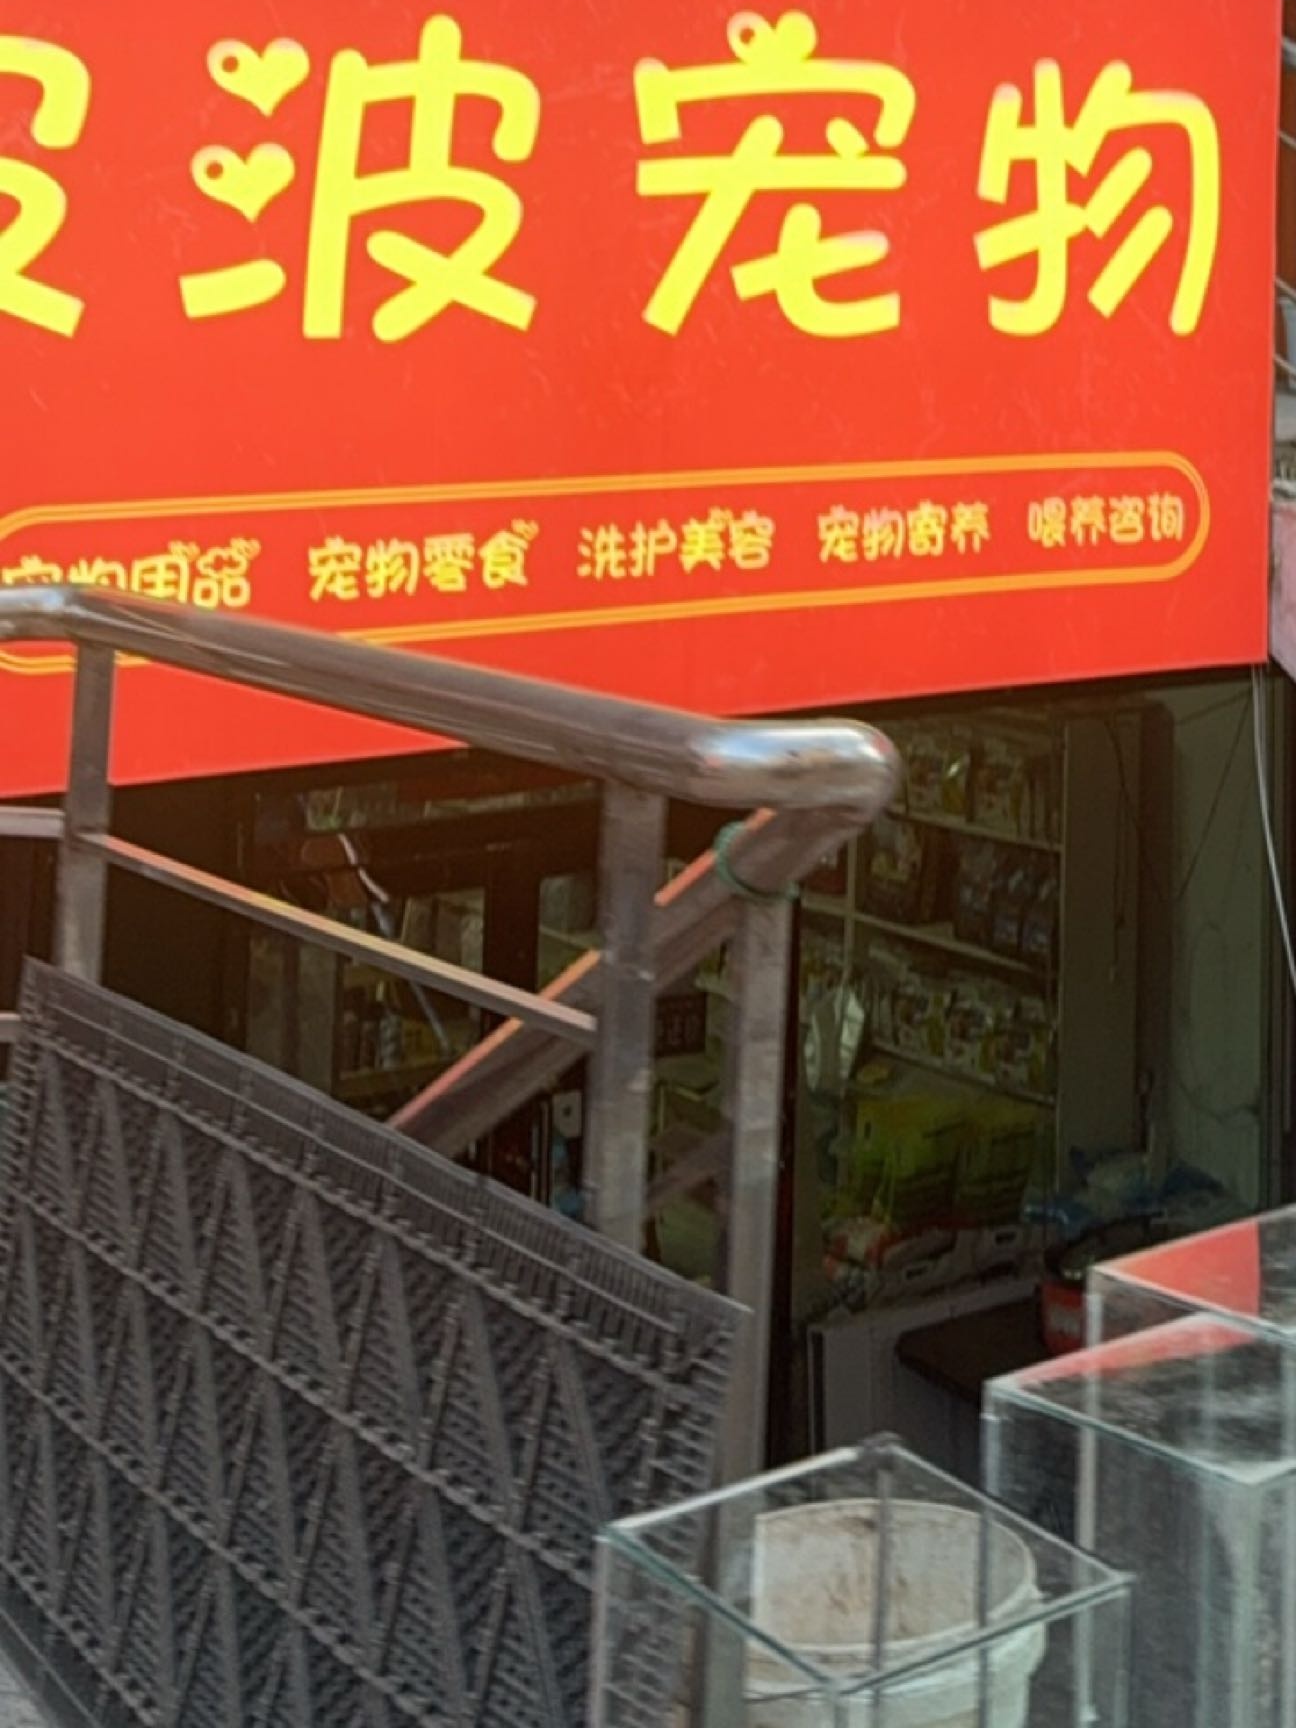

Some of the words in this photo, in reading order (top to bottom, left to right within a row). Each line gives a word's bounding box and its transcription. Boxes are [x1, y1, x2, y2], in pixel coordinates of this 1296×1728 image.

[0, 11, 1220, 342] 波宠物
[308, 519, 540, 603] 宠物零食
[577, 507, 776, 581] 洗护美容
[817, 498, 991, 564] 宠物寄养
[1028, 492, 1185, 549] 喂养咨询
